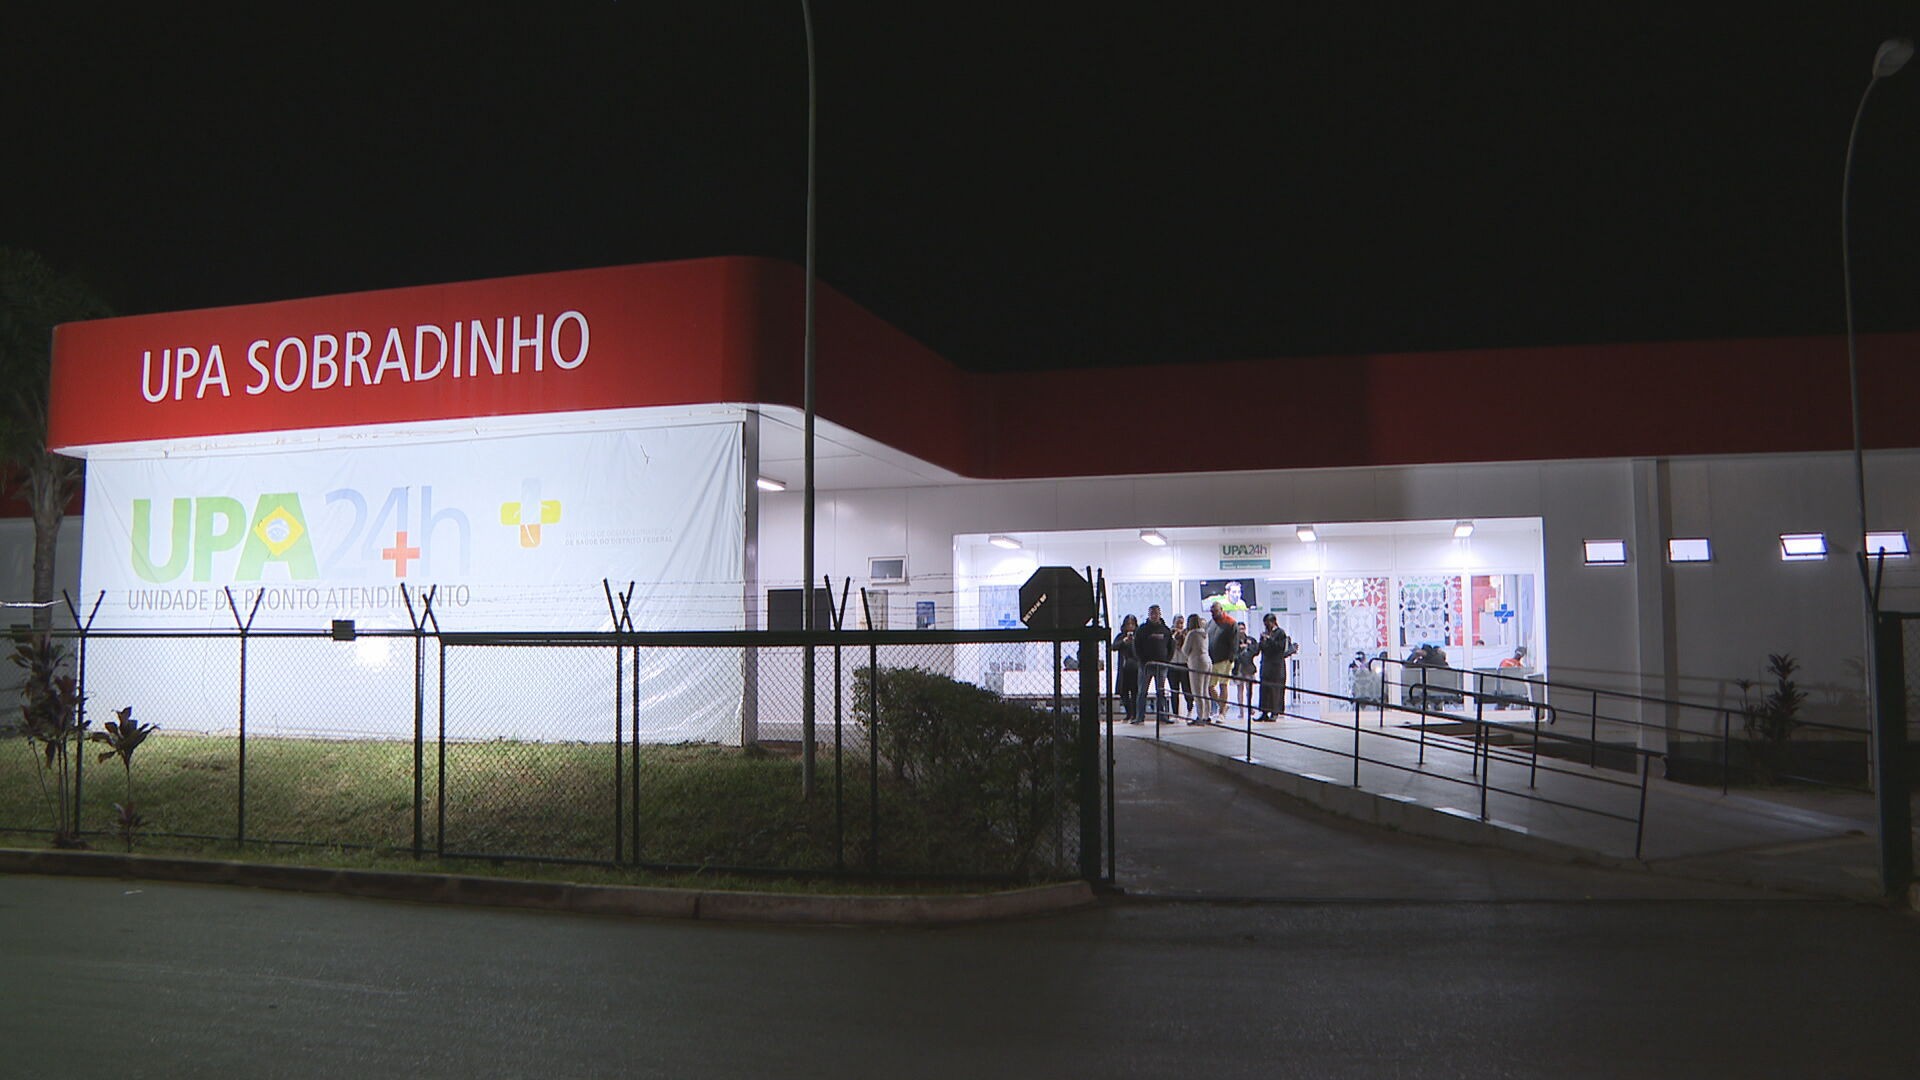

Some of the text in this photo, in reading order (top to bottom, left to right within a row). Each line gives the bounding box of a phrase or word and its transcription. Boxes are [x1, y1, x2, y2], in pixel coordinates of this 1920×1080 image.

[142, 310, 590, 402] UPA SOBRADINHO
[131, 492, 320, 583] UPA
[128, 589, 208, 611] UNIDADE
[325, 584, 470, 610] ATENDIMENTO
